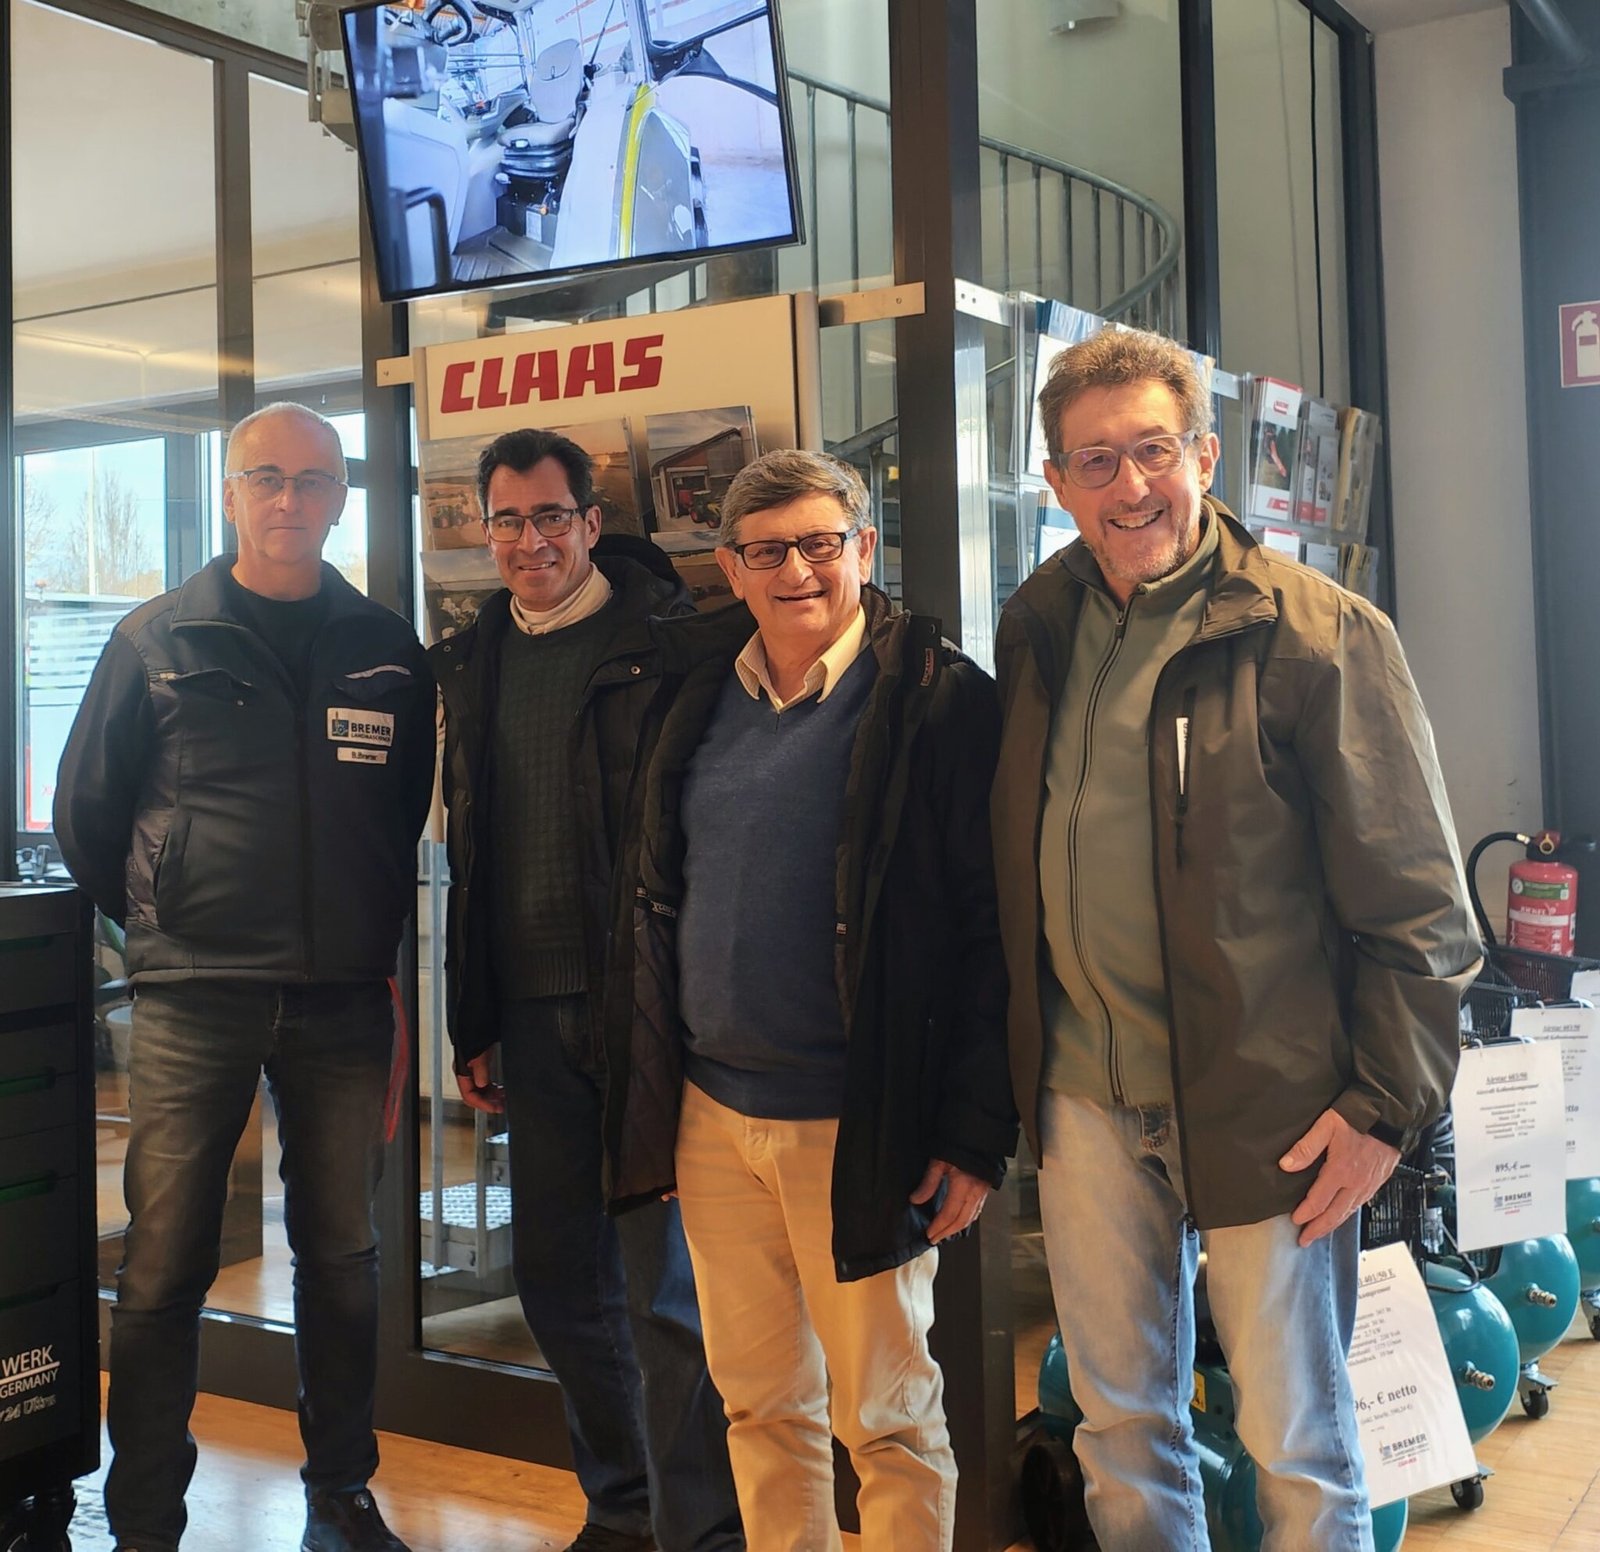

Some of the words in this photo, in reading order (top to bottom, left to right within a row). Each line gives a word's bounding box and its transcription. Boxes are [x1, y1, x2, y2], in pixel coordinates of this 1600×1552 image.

[440, 334, 664, 414] CLAAS
[351, 722, 391, 736] BREMER
[2, 1344, 53, 1377] WERK
[0, 1368, 58, 1399] GERMANY
[1388, 1384, 1417, 1402] netto
[1391, 1433, 1428, 1451] BREMER
